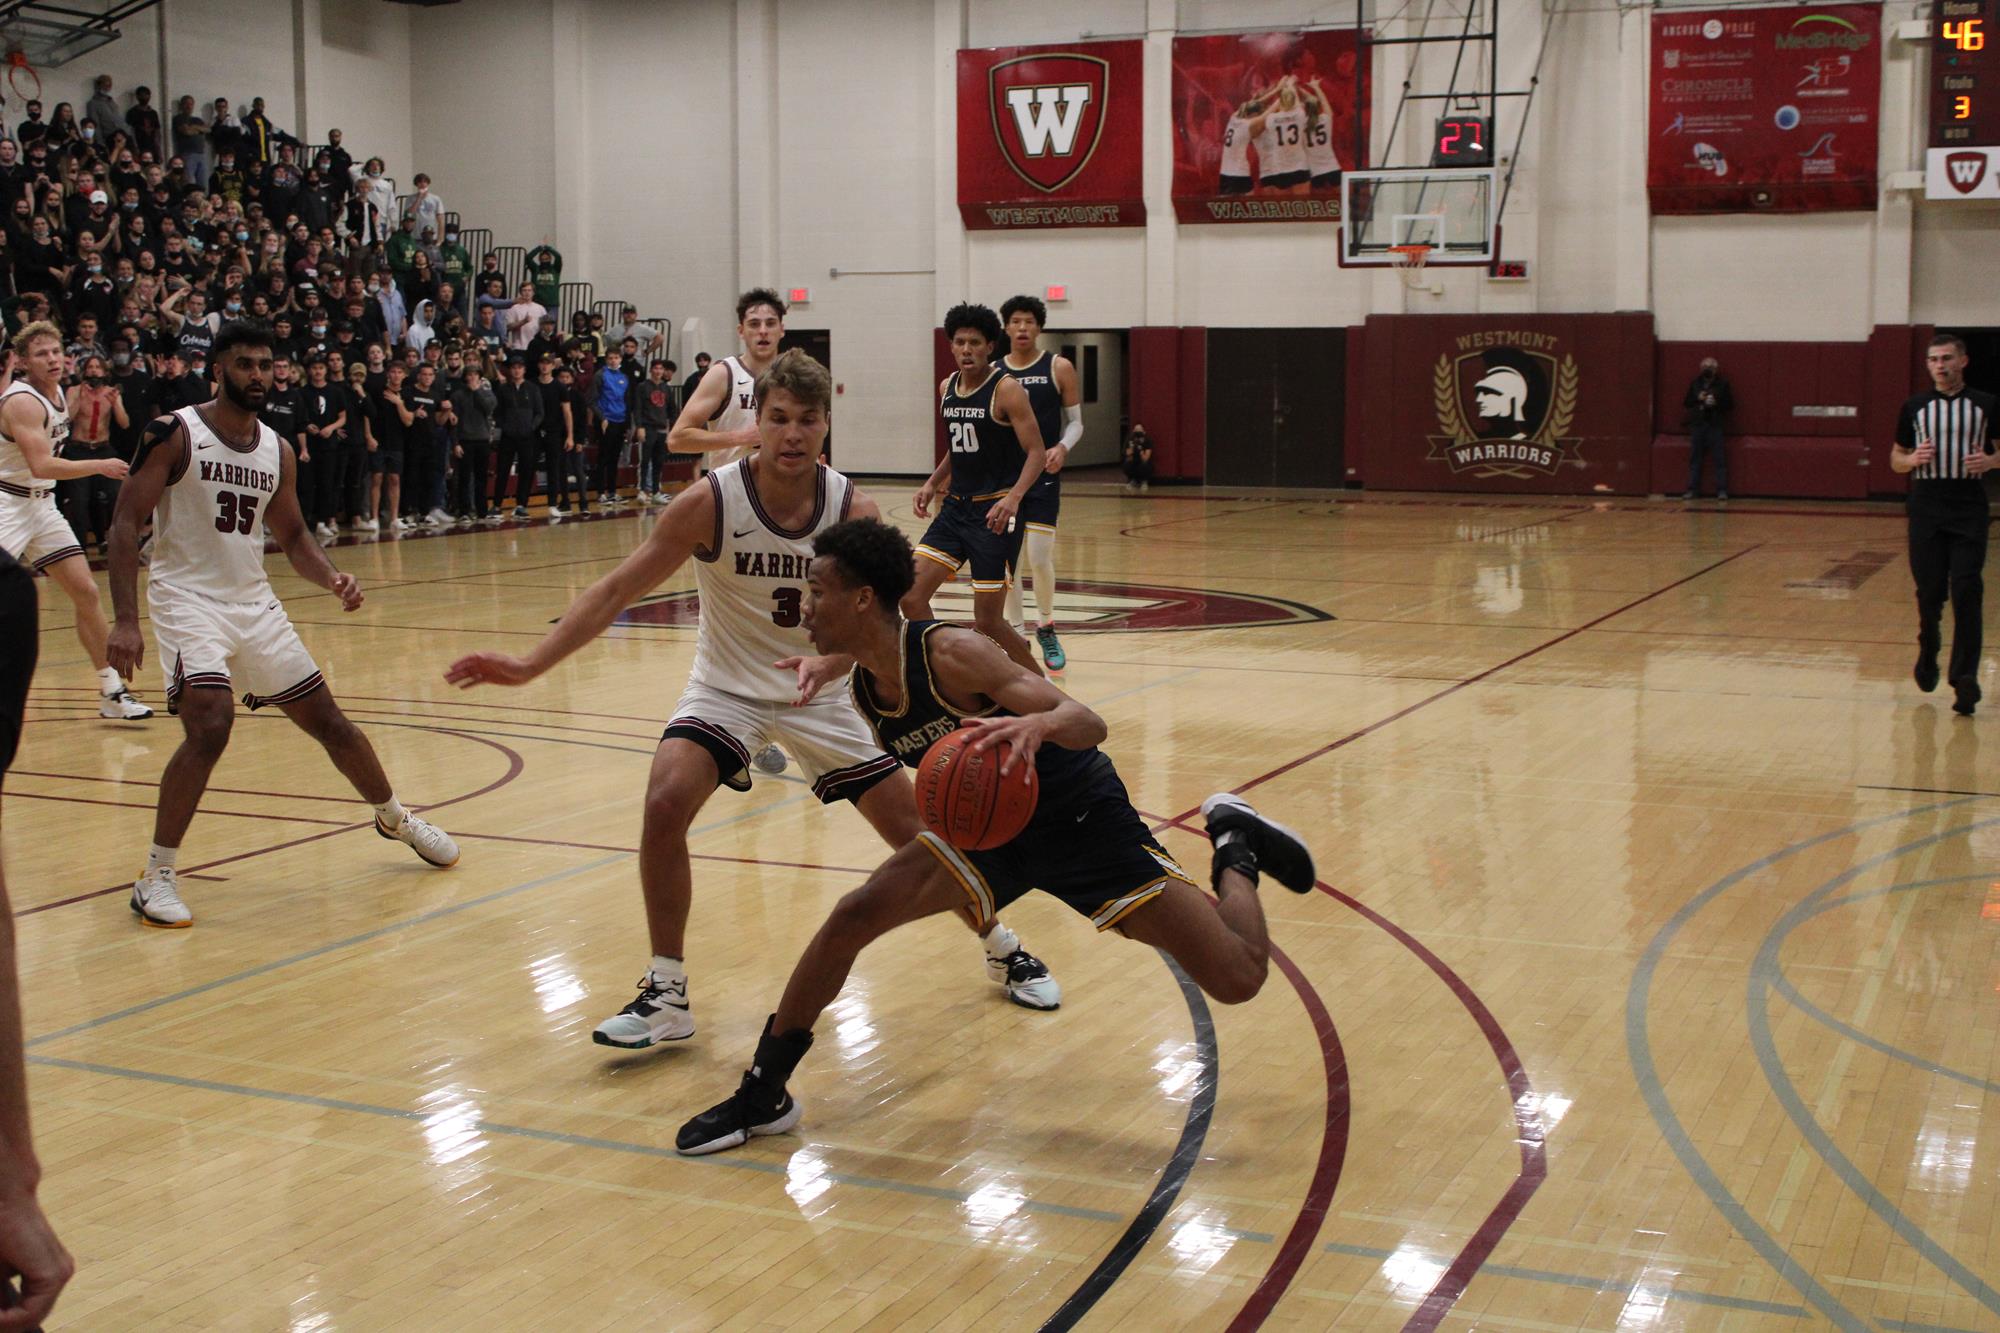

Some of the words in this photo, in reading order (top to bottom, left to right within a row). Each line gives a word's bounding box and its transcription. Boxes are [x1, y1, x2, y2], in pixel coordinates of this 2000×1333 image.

[1775, 31, 1871, 51] MedBridge
[1942, 19, 1985, 51] 46
[1953, 95, 1971, 119] 3
[1005, 82, 1093, 158] W
[1275, 123, 1300, 146] 13
[1305, 124, 1328, 147] 15
[1440, 122, 1483, 154] 27
[1951, 161, 1982, 183] W
[986, 205, 1120, 225] WESTMONT
[1207, 200, 1341, 218] WARRIORS
[1456, 331, 1558, 350] WESTMONT
[943, 406, 986, 419] MASTER'S
[950, 422, 980, 453] 20
[1456, 444, 1553, 466] WARRIORS
[200, 460, 275, 494] WARRIORS
[214, 490, 260, 536] 35
[734, 551, 814, 580] WARRI
[771, 586, 803, 628] 3
